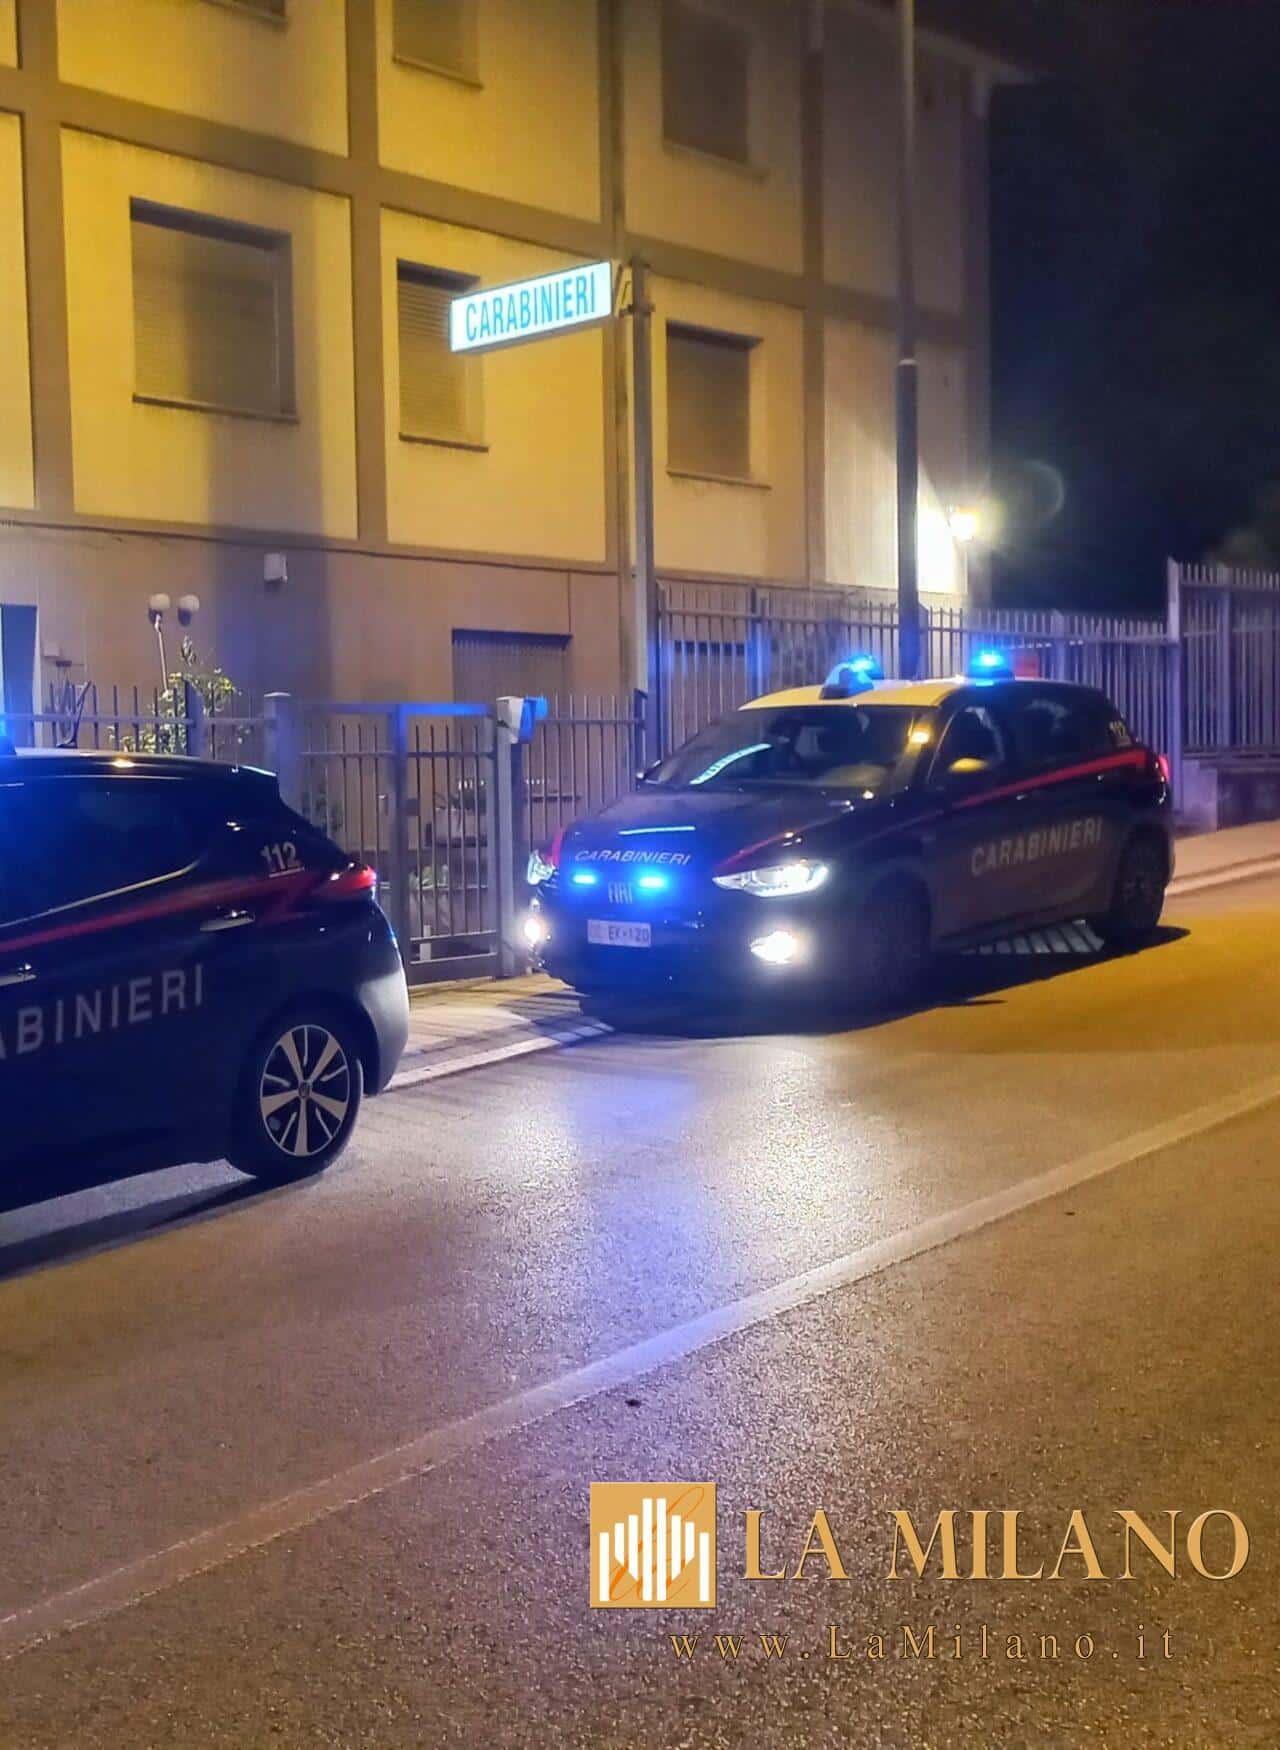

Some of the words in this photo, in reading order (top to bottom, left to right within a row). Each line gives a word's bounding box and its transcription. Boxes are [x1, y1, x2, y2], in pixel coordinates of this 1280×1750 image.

[465, 271, 596, 342] CARABINIERI
[260, 841, 301, 873] 112
[575, 849, 691, 865] CARABINIERI
[970, 816, 1103, 876] CARABINIERI
